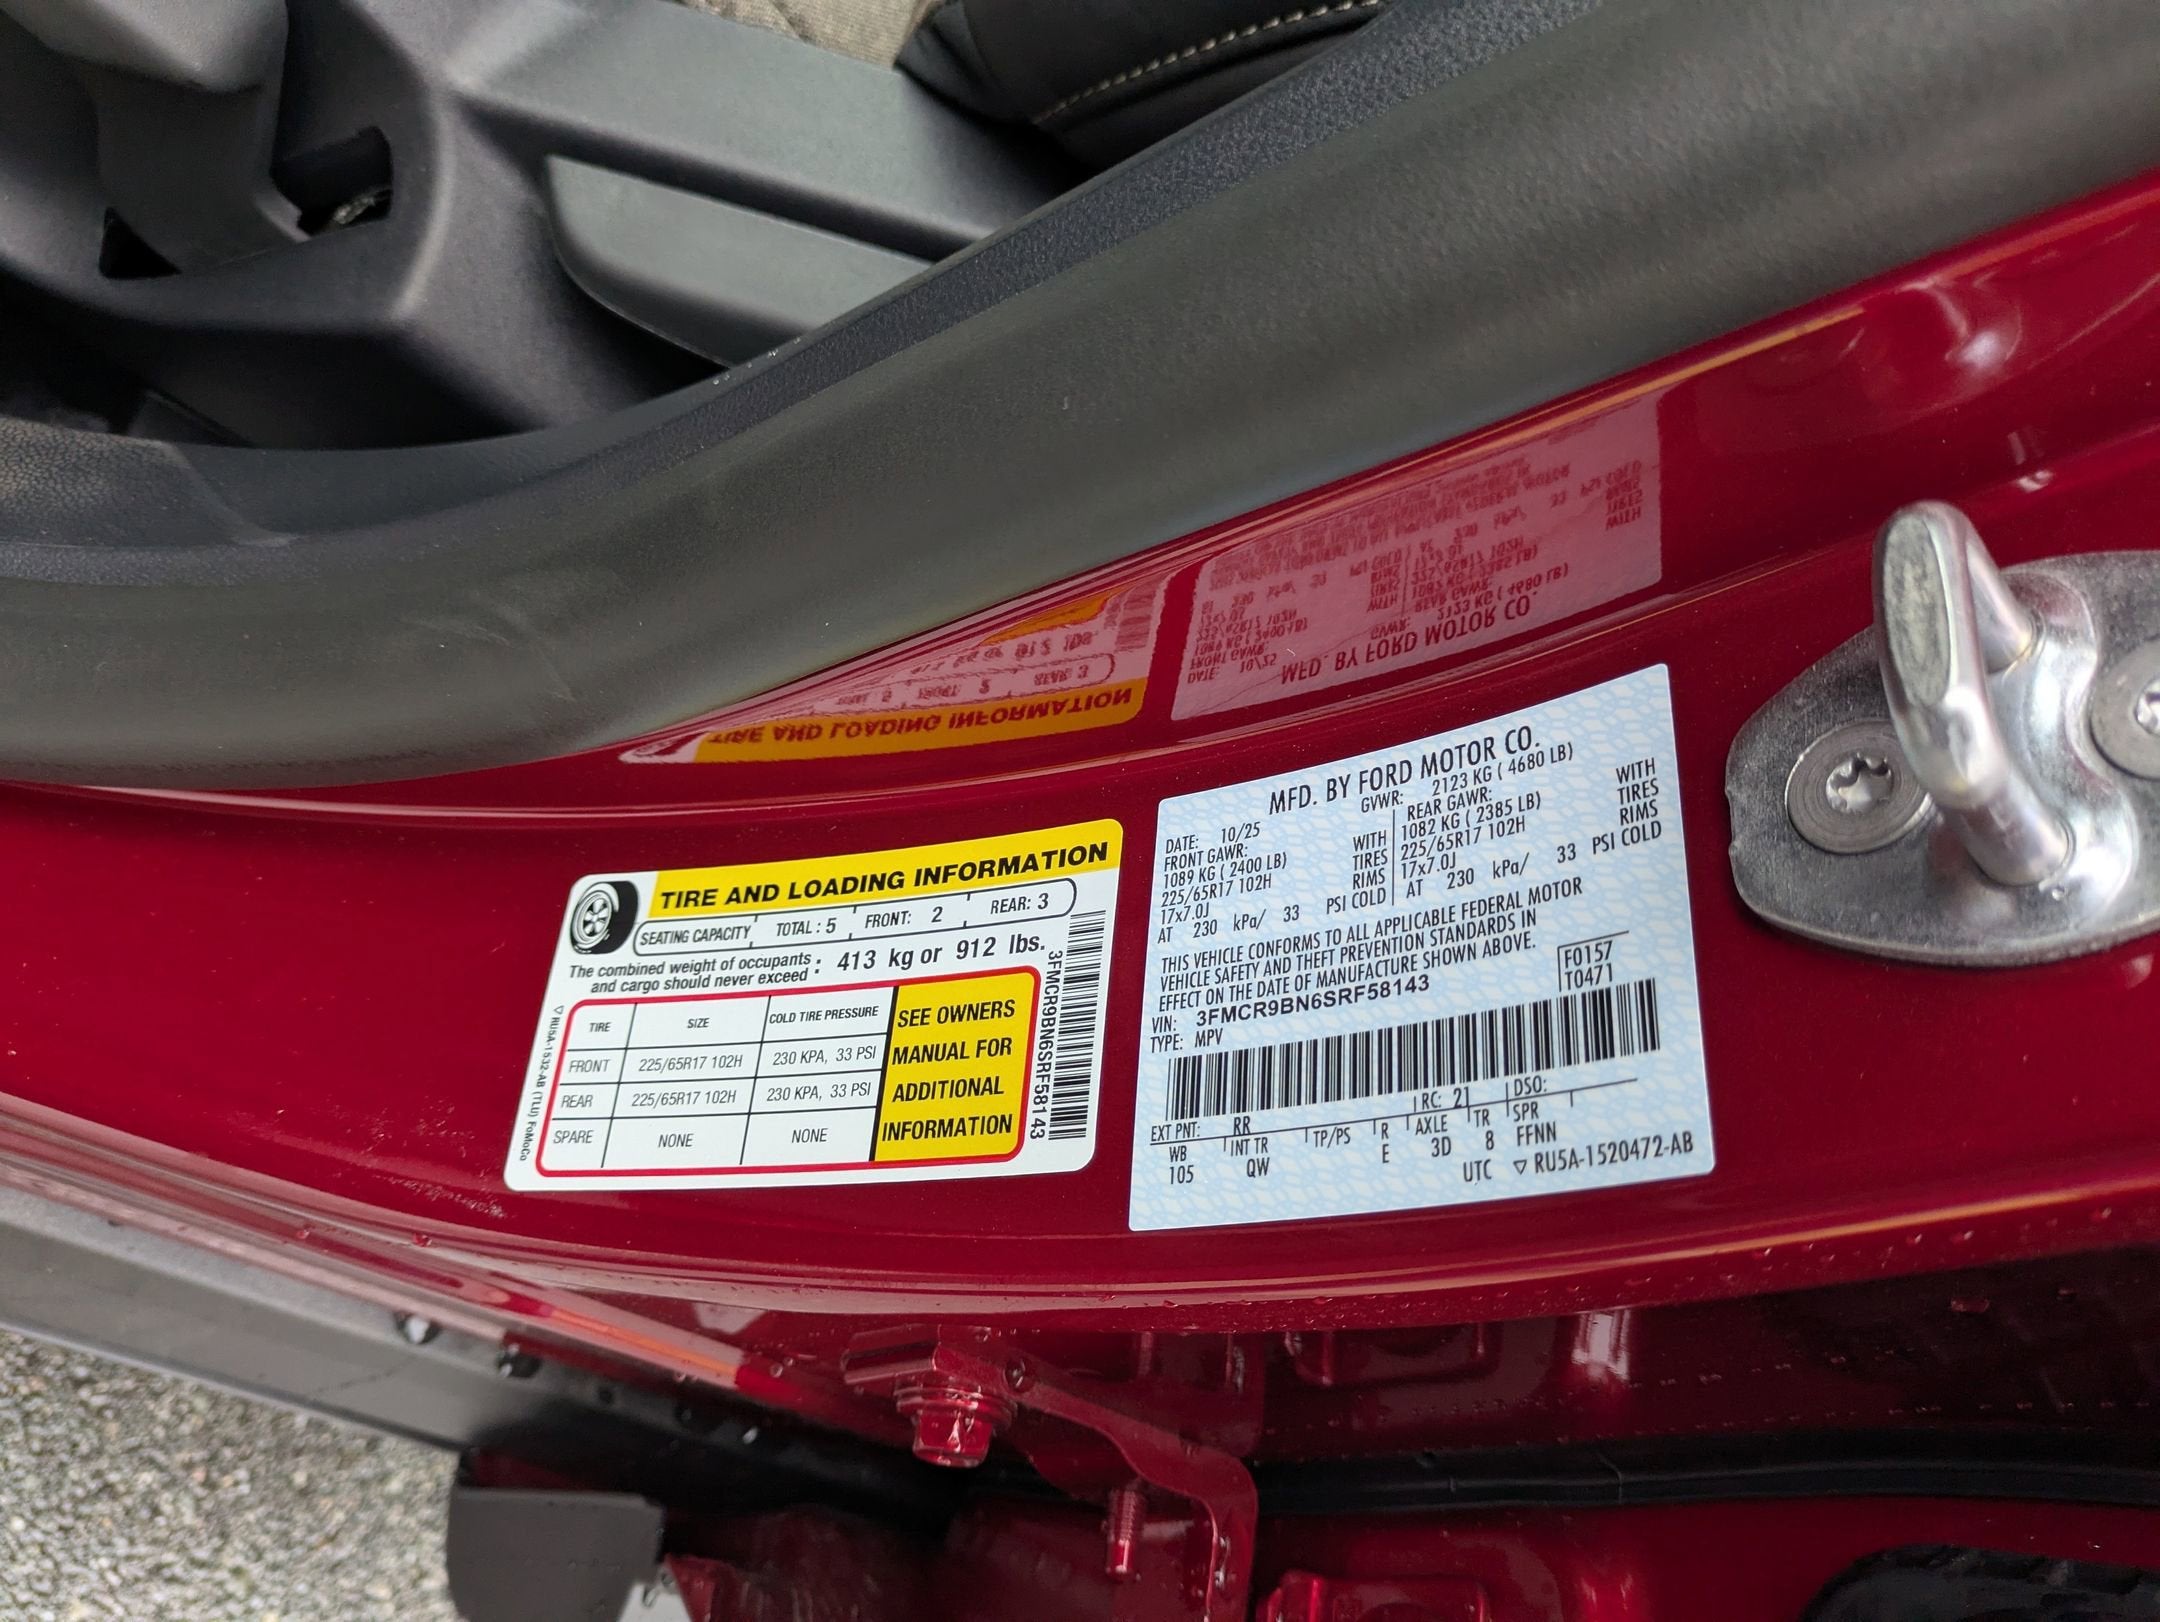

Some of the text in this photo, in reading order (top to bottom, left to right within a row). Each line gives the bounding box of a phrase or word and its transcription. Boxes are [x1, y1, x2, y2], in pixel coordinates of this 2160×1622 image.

[1269, 726, 1540, 815] MFD. BY FORD MOTOR CO.
[1361, 751, 1545, 813] GVWR: 2123 4680
[1616, 757, 1656, 784] WITH
[1407, 786, 1493, 822] REAR GAWR:
[1617, 778, 1660, 805] TIRES
[1401, 798, 1513, 841] 1082 2385
[1619, 800, 1658, 826] RIMS
[1165, 822, 1260, 854] DATE: 10/25
[1352, 830, 1388, 851] WITH
[1400, 816, 1526, 861] 225/65R17 102H
[1164, 843, 1248, 872] FRONT GAWR:
[1352, 849, 1388, 871] TIRES
[1401, 852, 1457, 880] 17x7.0J
[1447, 821, 1662, 890] 230 kPa/ 33 PSI COLD
[661, 841, 1108, 909] TIRE AND LOADING INFORMATION
[1164, 857, 1262, 889] 1089 2400
[1353, 868, 1386, 890] RIMS
[990, 893, 1049, 915] REAR: 3
[1161, 874, 1272, 908] 225/65R17 102H
[865, 906, 943, 929] FRONT: 2
[1160, 902, 1210, 925] 17x7.0J
[1162, 877, 1583, 974] THIS VEHICLE CONFORMS TO ALL APPLICABLE FEDERAL MOTOR
[1193, 887, 1386, 939] 230 kPa/ 33 PSI COLD
[640, 930, 689, 946] SEATING
[693, 926, 751, 943] CAPACITY
[825, 918, 836, 933] 5
[837, 933, 1045, 971] 413 kg or 912 lbs.
[1160, 908, 1537, 993] VEHICLE SAFETY AND THEFT PREVENTION STANDARDS IN
[1564, 940, 1613, 969] F0157
[570, 952, 811, 978] The combined weight of occupants
[1160, 932, 1536, 1012] EFFECT ON THE DATE OF MANUFACTURE SHOWN ABOVE.
[1564, 963, 1613, 990] T0471
[591, 969, 808, 994] and cargo should never exceed
[897, 999, 1016, 1027] SEE OWNERS
[1152, 974, 1430, 1034] VIN: 3FMCR9BN6SRF58143
[589, 1006, 879, 1032] TIRE SIZE COLD TIRE PRESSURE
[892, 1037, 1013, 1065] MANUAL FOR
[1030, 951, 1063, 1139] 3FMCR9BN6SRF58143
[1150, 1028, 1224, 1053] TYPE: MPV
[569, 1046, 876, 1074] FRONT 225/65R17 102H 230 KPA, 33 PSI
[561, 1082, 871, 1109] REAR 225/65R17 102H 230 KPA, 33 PSI
[892, 1076, 1004, 1102] ADDITIONAL
[1514, 1076, 1547, 1097] DSO:
[528, 1091, 543, 1117] (TLU)
[520, 1121, 537, 1161] FoMoCo
[553, 1128, 828, 1148] SPARE NONE NONE
[882, 1114, 1013, 1142] INFORMATION
[1151, 1116, 1250, 1142] EXT PNT: RR
[1169, 1102, 1539, 1163] WB TP/PS AXLE SPR
[1169, 1122, 1557, 1185] 105 QW 3D FFNN
[1463, 1130, 1694, 1182] UTC RU5A-1520472-AB
